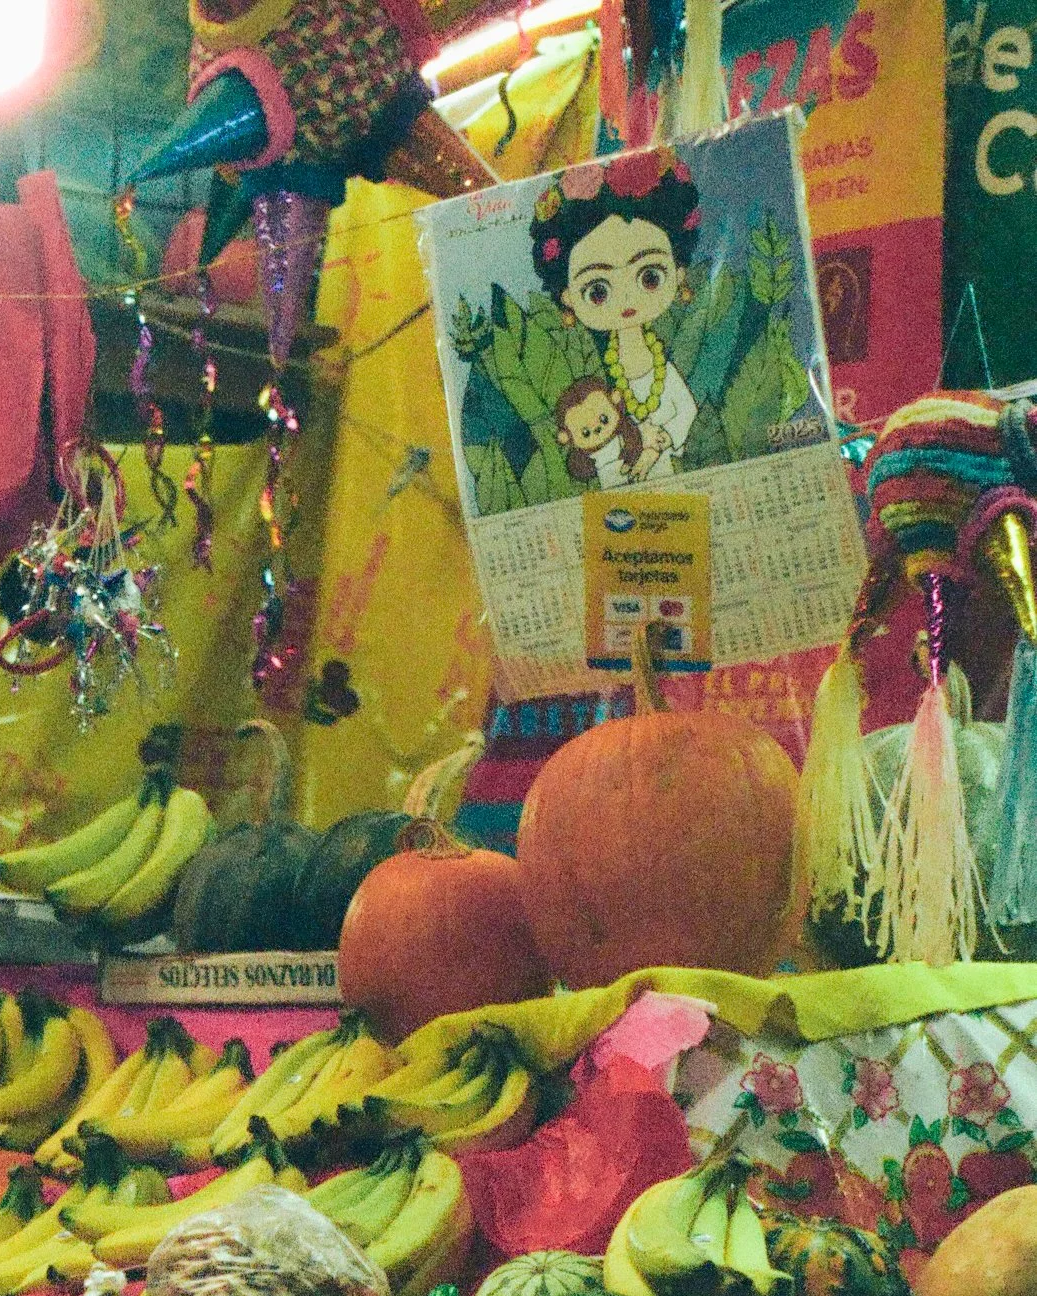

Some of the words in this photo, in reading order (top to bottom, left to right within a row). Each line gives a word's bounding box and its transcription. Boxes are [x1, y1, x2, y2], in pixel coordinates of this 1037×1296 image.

[974, 109, 1037, 196] C
[602, 548, 694, 566] Aceptamos
[619, 568, 680, 587] tarjetas
[613, 601, 640, 613] VISA
[158, 963, 240, 989] SELECTOS
[244, 962, 336, 988] DURAZNOS
